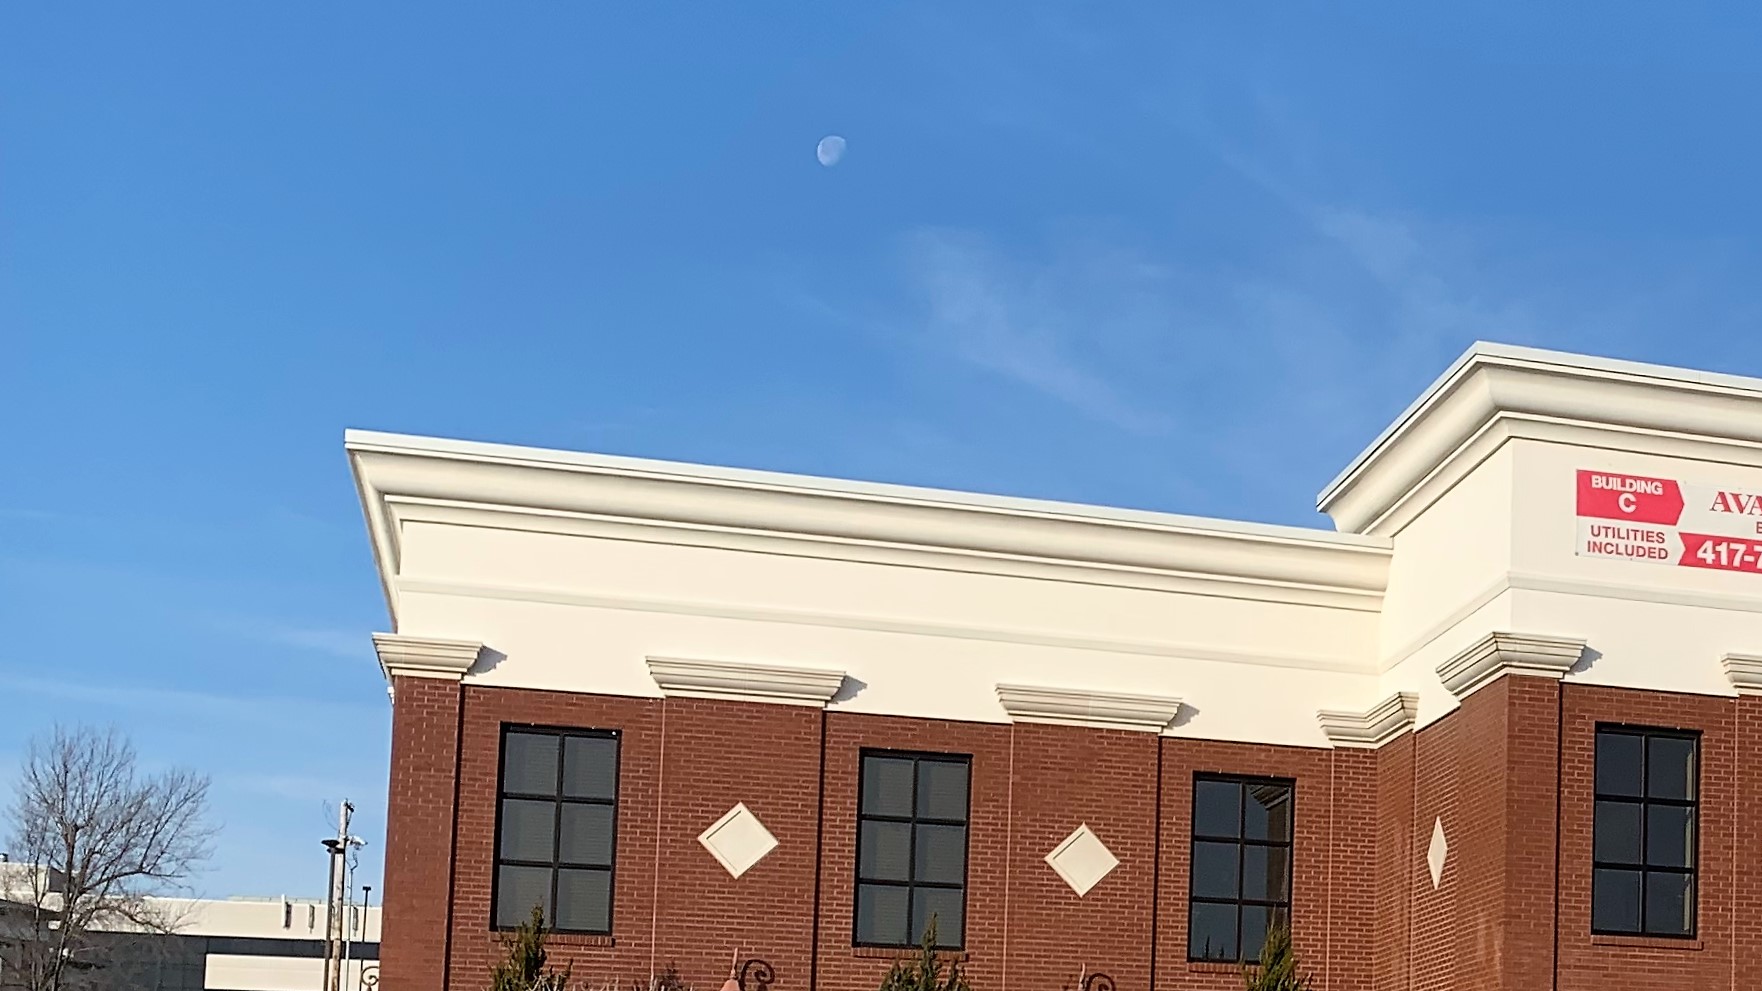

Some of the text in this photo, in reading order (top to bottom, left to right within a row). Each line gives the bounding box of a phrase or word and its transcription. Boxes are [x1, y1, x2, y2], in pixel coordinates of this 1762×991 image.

[1591, 475, 1663, 495] BUILDING
[1618, 492, 1637, 513] C
[1590, 525, 1666, 544] UTILITIES
[1587, 540, 1668, 560] INCLUDED
